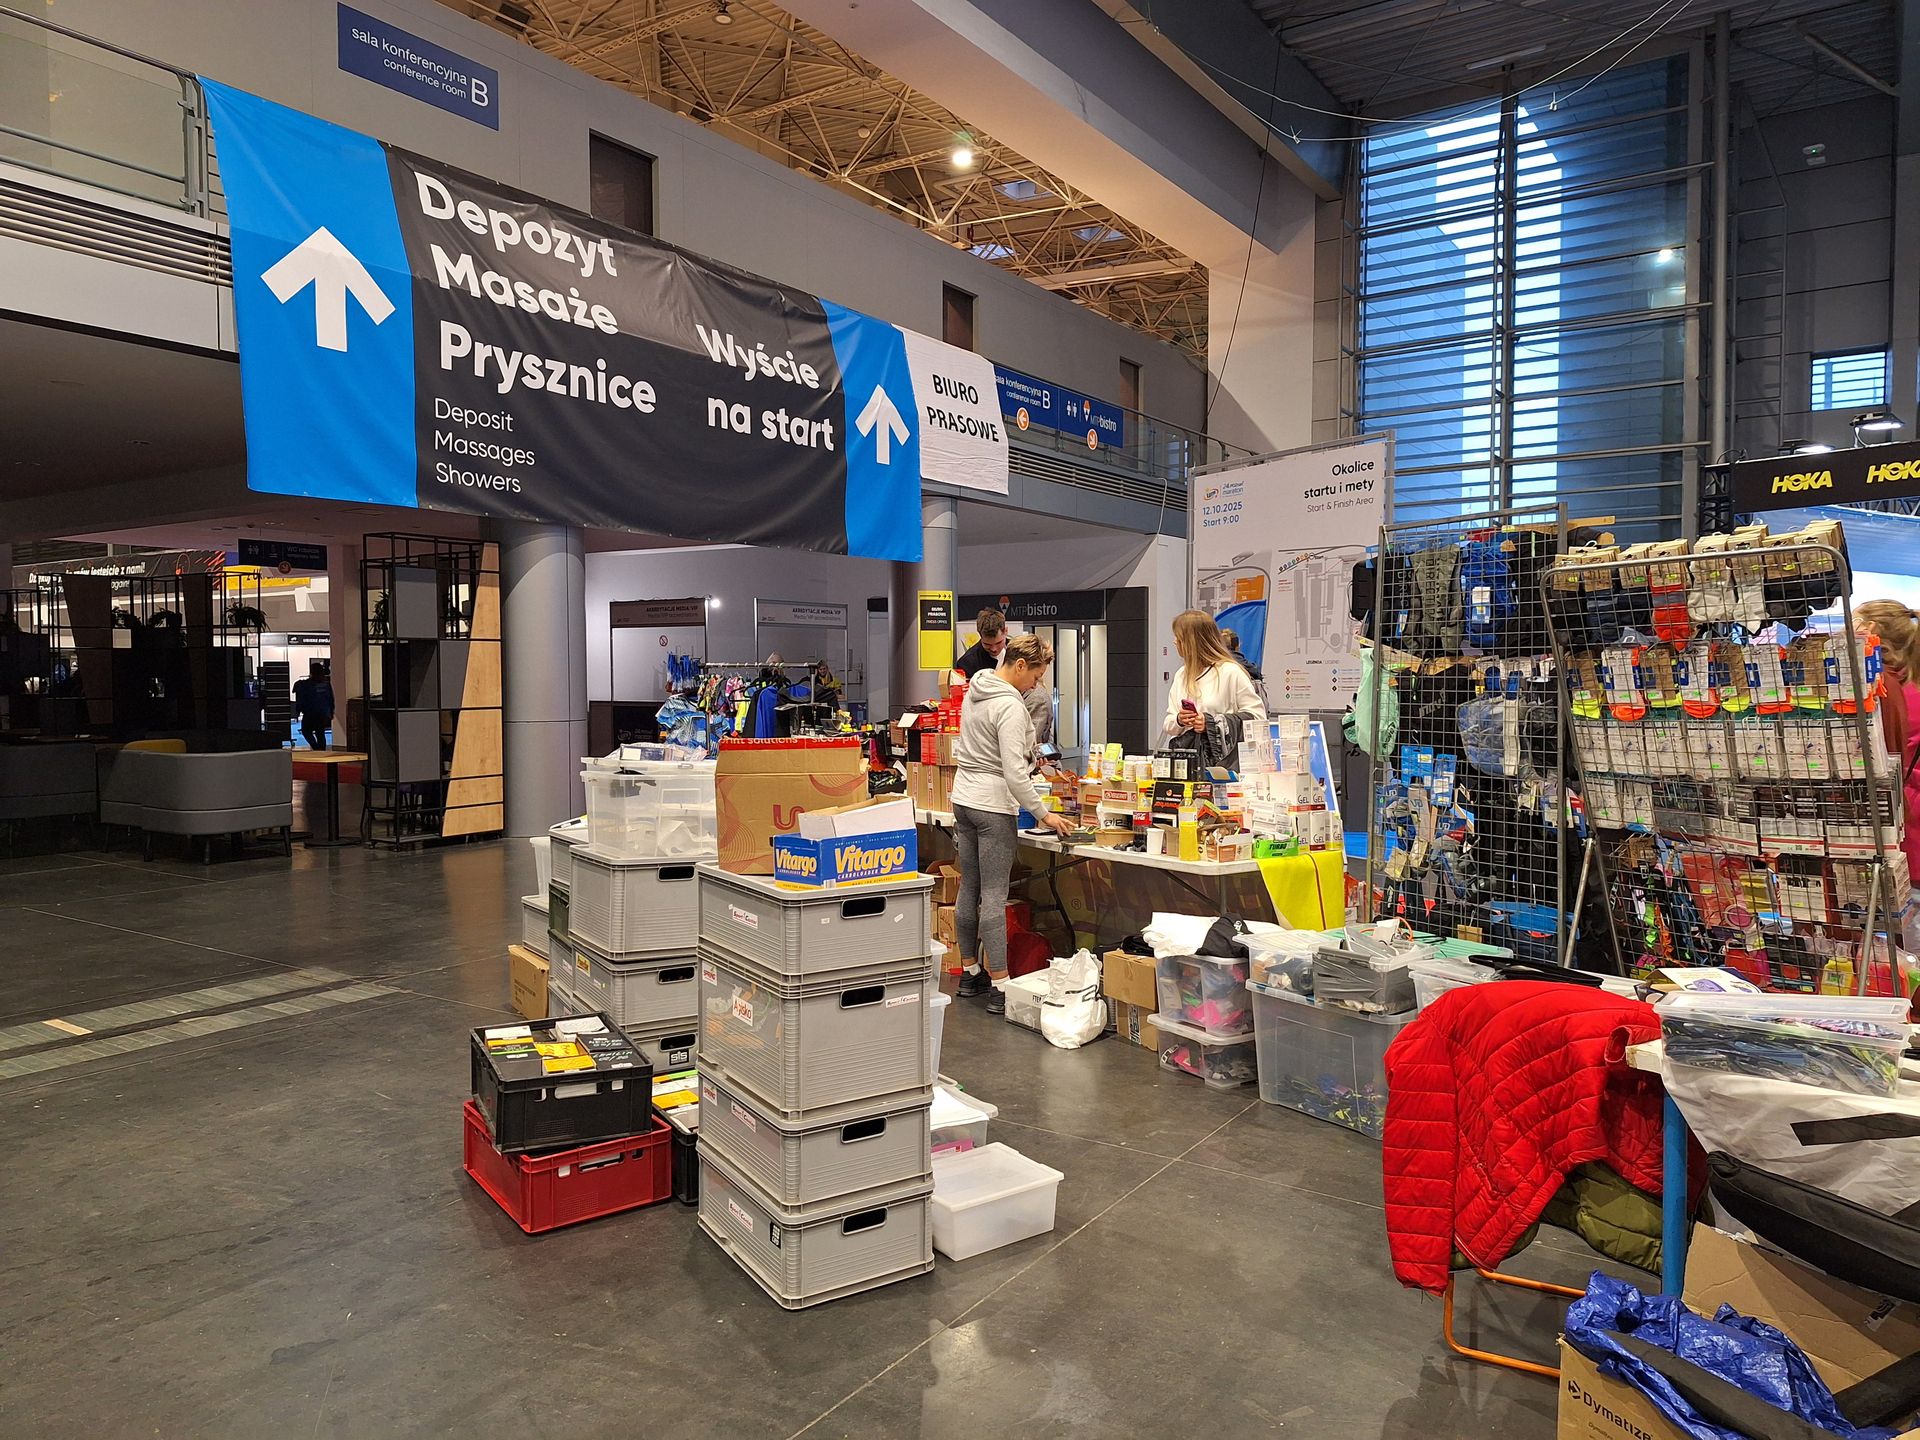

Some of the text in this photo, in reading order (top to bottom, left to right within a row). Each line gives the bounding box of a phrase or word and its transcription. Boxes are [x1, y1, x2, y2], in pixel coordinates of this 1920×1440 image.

[351, 27, 468, 87] sala konferencyjna
[383, 58, 467, 99] conference room
[471, 77, 489, 108] B
[414, 171, 618, 278] Depozyt
[430, 243, 619, 335] Masaże
[440, 320, 657, 414] Prysznice
[695, 323, 820, 389] Wyście
[931, 373, 979, 405] BIURO
[1042, 390, 1051, 409] B
[434, 397, 514, 432] Deposit
[707, 396, 834, 451] na start
[926, 406, 1000, 443] PRASOWE
[434, 429, 536, 467] Massages
[435, 462, 522, 494] Showers
[1331, 460, 1375, 477] Okolice
[1771, 470, 1833, 494] HOKA
[1866, 460, 1920, 484] HOK
[1303, 479, 1375, 499] startu i mety
[1306, 496, 1375, 513] Start & Finish Area
[1202, 501, 1243, 516] 12.10.2025
[1203, 514, 1240, 528] Start 9:00
[1297, 794, 1310, 804] GEL
[1313, 793, 1325, 803] GEL
[1313, 833, 1325, 844] GEL
[775, 848, 817, 877] Vitargo
[834, 844, 906, 875] Vitargo
